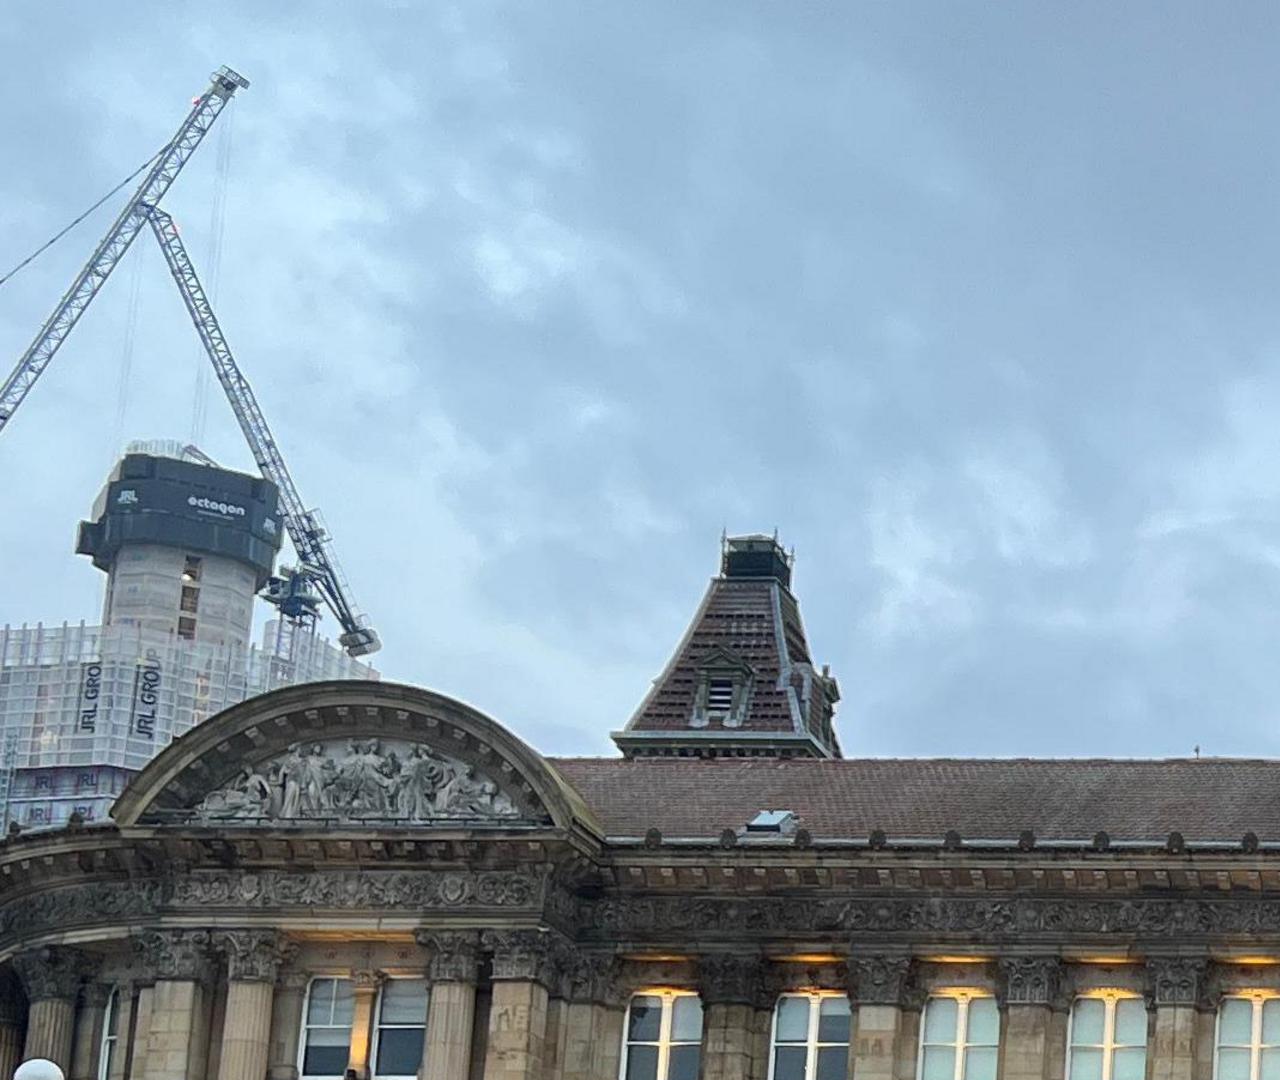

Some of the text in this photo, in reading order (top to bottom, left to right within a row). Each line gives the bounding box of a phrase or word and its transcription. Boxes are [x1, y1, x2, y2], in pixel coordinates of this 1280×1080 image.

[187, 495, 245, 516] octagon
[135, 647, 161, 740] JRL GROUP
[81, 703, 98, 734] JRL
